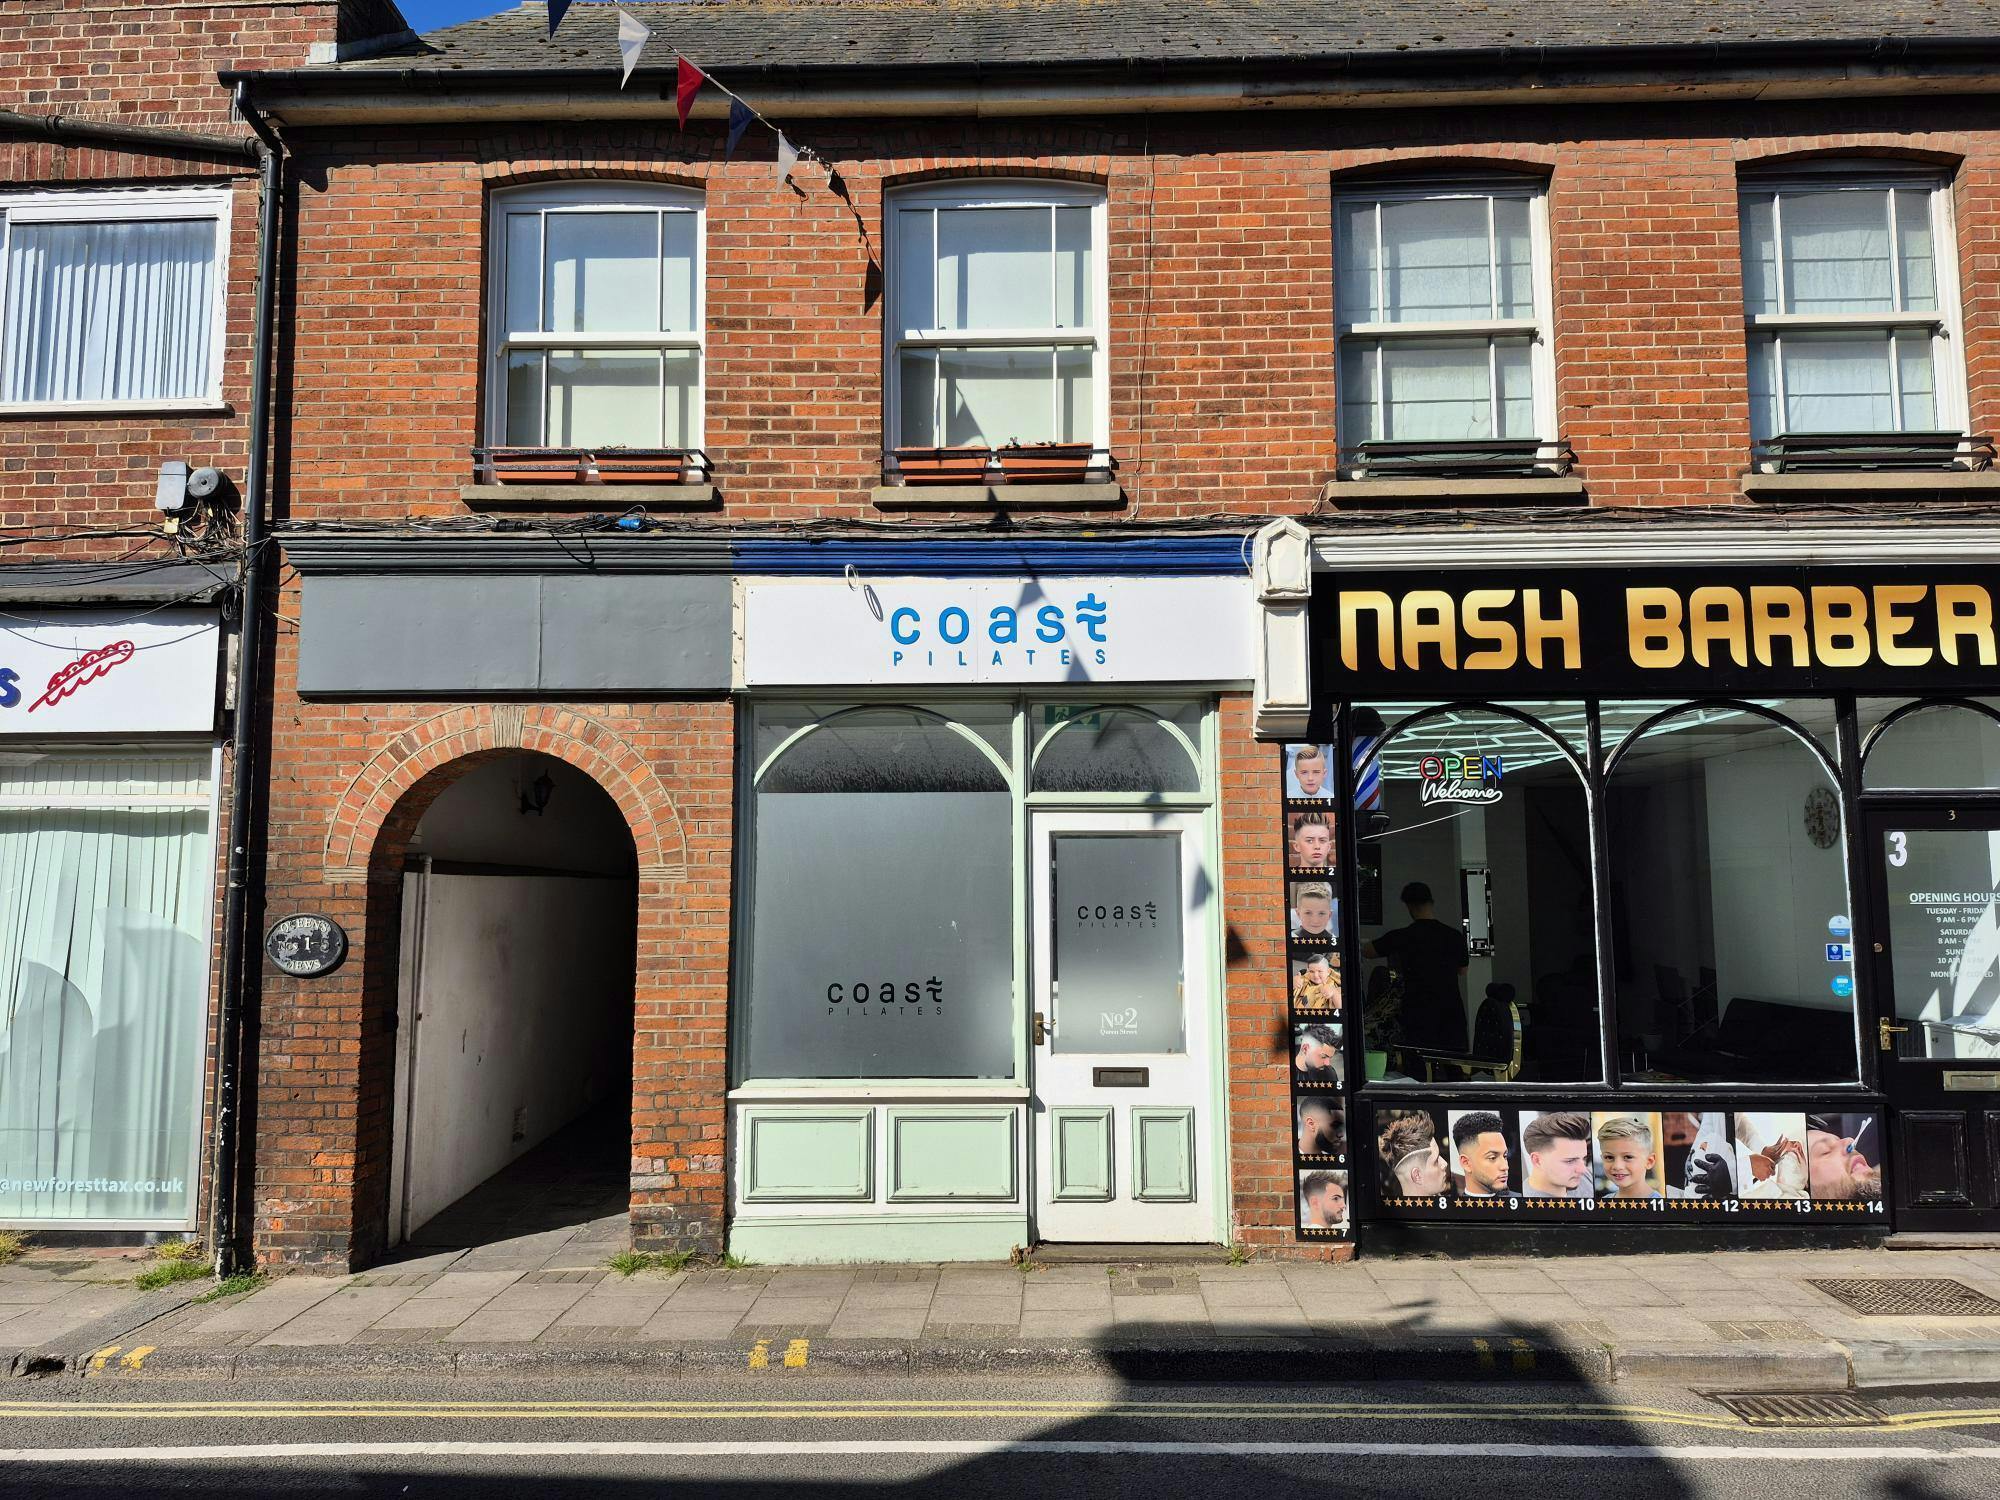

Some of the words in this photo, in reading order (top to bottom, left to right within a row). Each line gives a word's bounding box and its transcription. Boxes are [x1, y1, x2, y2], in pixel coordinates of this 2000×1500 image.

[890, 593, 1107, 645] coast
[1339, 588, 1582, 671] NASH
[1626, 584, 1998, 668] BARBER
[893, 649, 1106, 667] PILATES
[1420, 756, 1503, 780] OPEN
[1421, 778, 1503, 804] Welcome
[1326, 798, 1332, 807] 1
[1948, 809, 1956, 821] 3
[1888, 831, 1908, 867] 3
[1328, 867, 1335, 876] 2
[1909, 892, 1961, 903] OPENING
[1077, 901, 1157, 920] coast
[1926, 907, 1957, 915] TUESDAY
[1078, 921, 1157, 929] PILATES
[1331, 937, 1337, 946] 3
[827, 976, 943, 1003] coast
[828, 1007, 942, 1016] PILATES
[1333, 1008, 1340, 1017] 4
[1336, 1081, 1343, 1090] 5
[1338, 1154, 1345, 1163] 6
[1438, 1196, 1448, 1210] 8
[1509, 1197, 1519, 1210] 9
[1578, 1198, 1595, 1211] 10
[1650, 1199, 1665, 1211] 11
[1722, 1199, 1739, 1212] 12
[1794, 1200, 1811, 1213] 13
[1866, 1200, 1884, 1213] 14
[1341, 1229, 1348, 1238] 7
